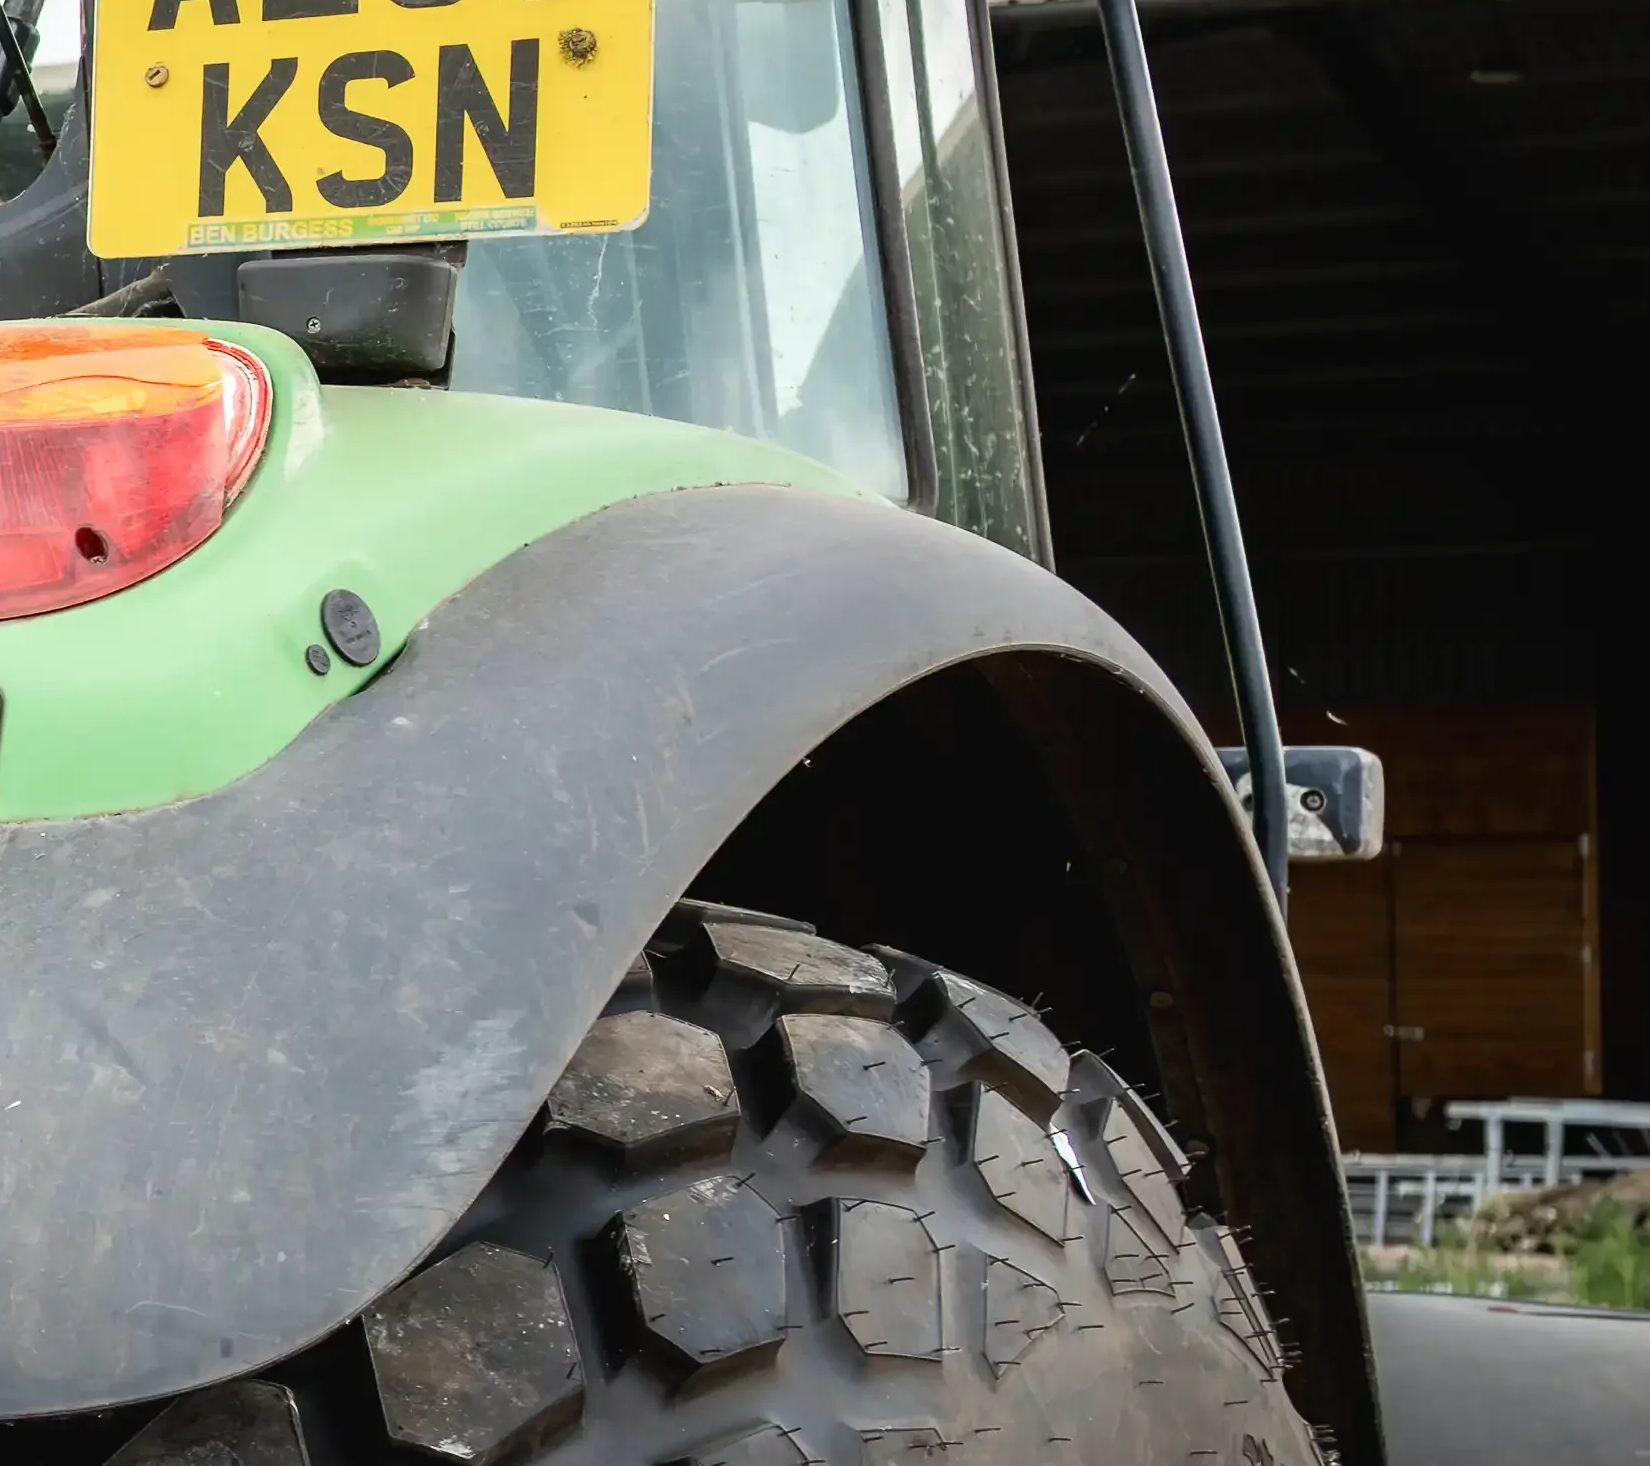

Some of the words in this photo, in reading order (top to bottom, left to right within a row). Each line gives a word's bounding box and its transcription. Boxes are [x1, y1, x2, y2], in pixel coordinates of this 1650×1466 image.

[198, 39, 539, 217] KSN
[190, 225, 236, 245] BEN
[242, 219, 353, 242] BURGESS
